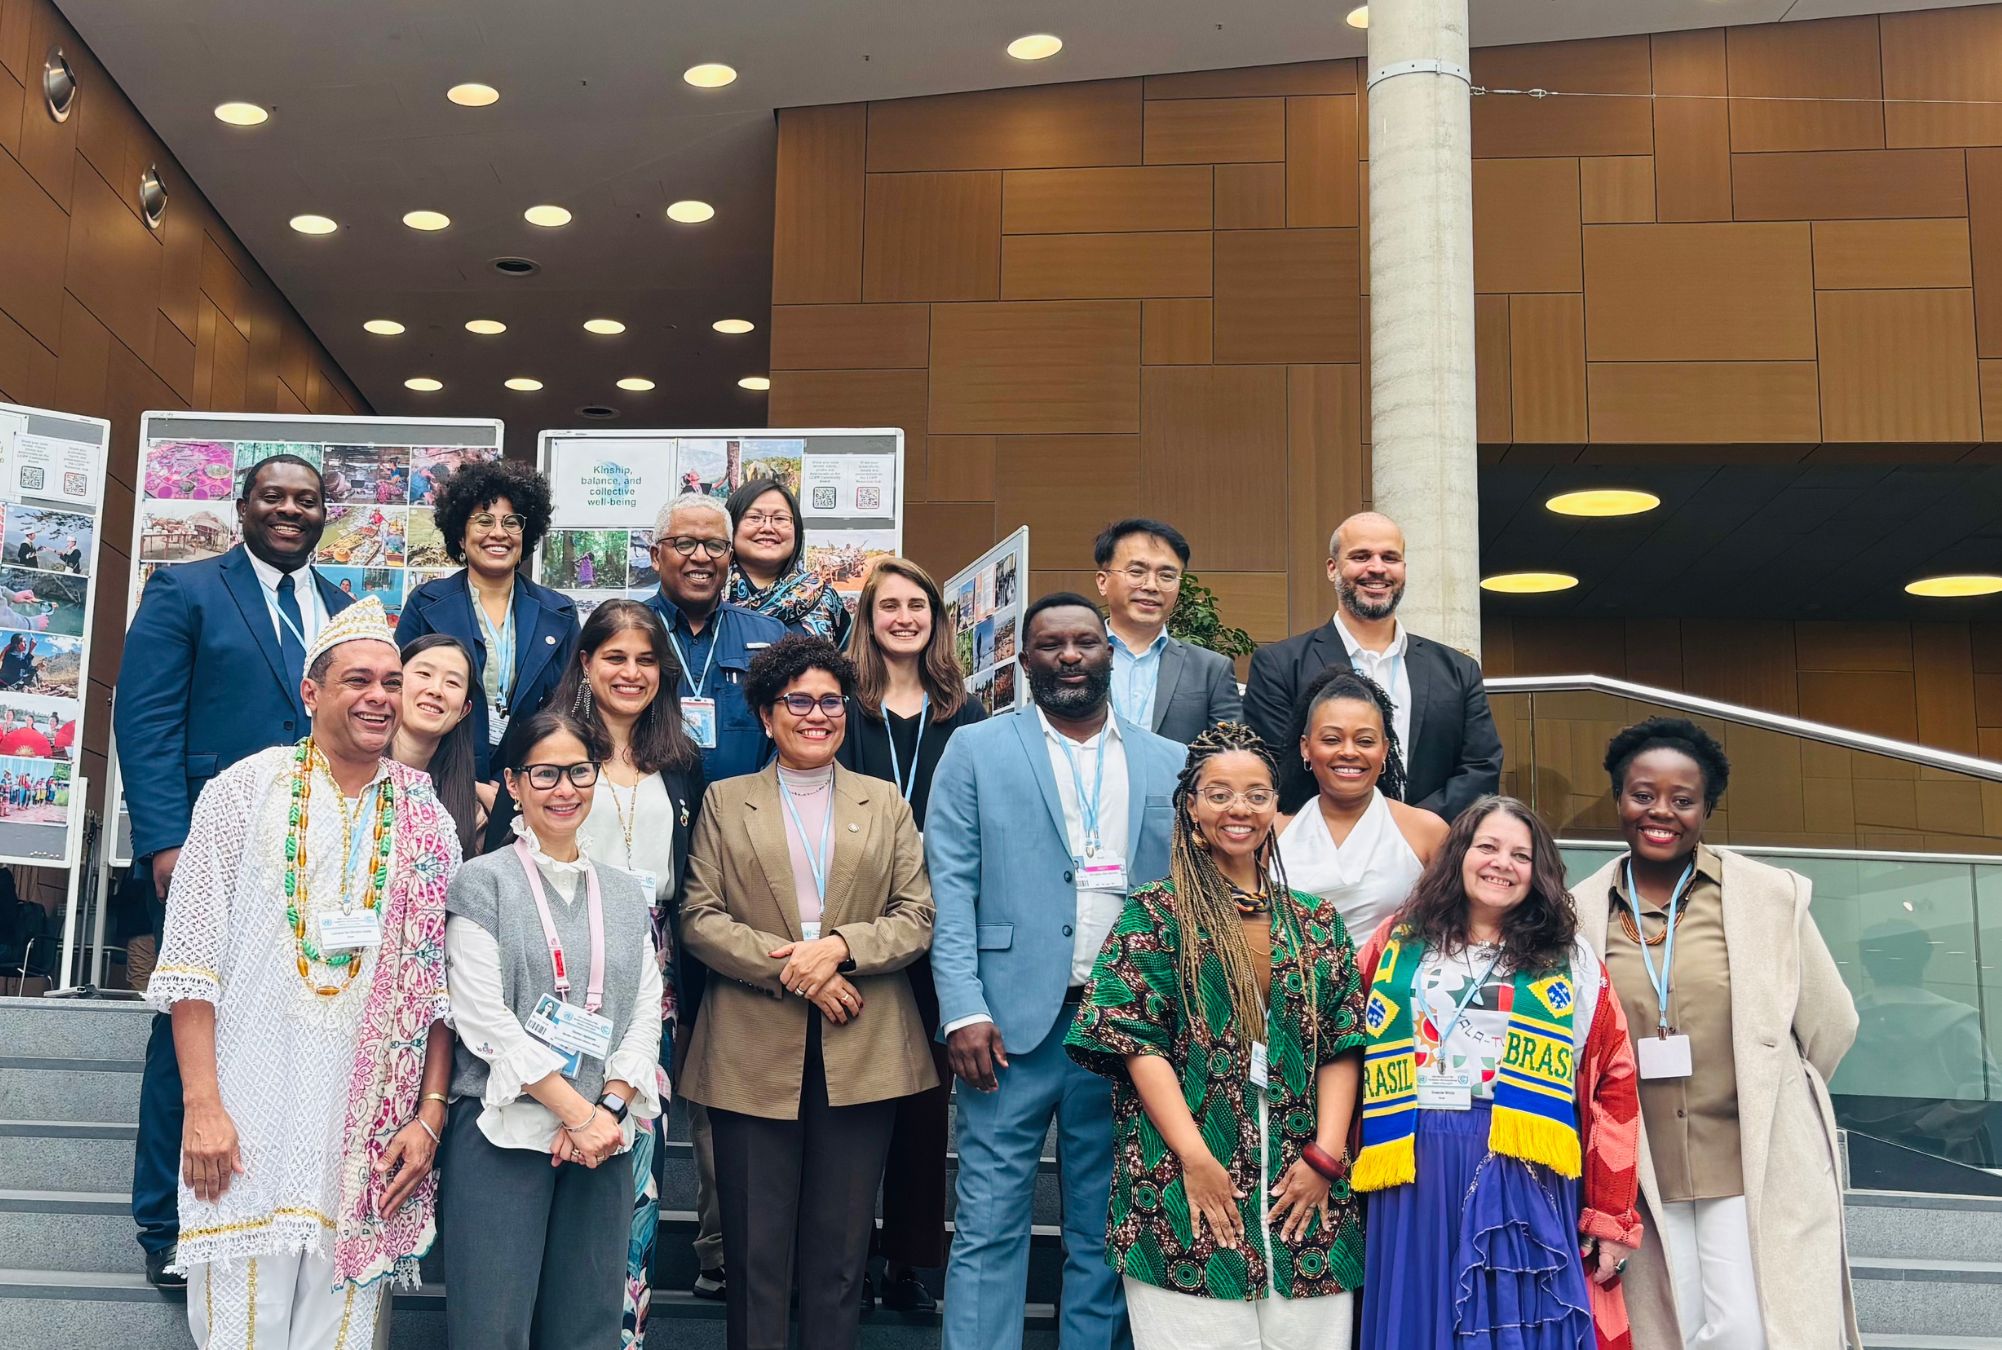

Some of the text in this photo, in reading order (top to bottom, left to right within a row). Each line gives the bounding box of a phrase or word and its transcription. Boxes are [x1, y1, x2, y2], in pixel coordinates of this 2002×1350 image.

[593, 465, 633, 475] Kinship,
[581, 476, 642, 486] balance, and
[589, 487, 635, 496] collective
[587, 497, 637, 507] well-being
